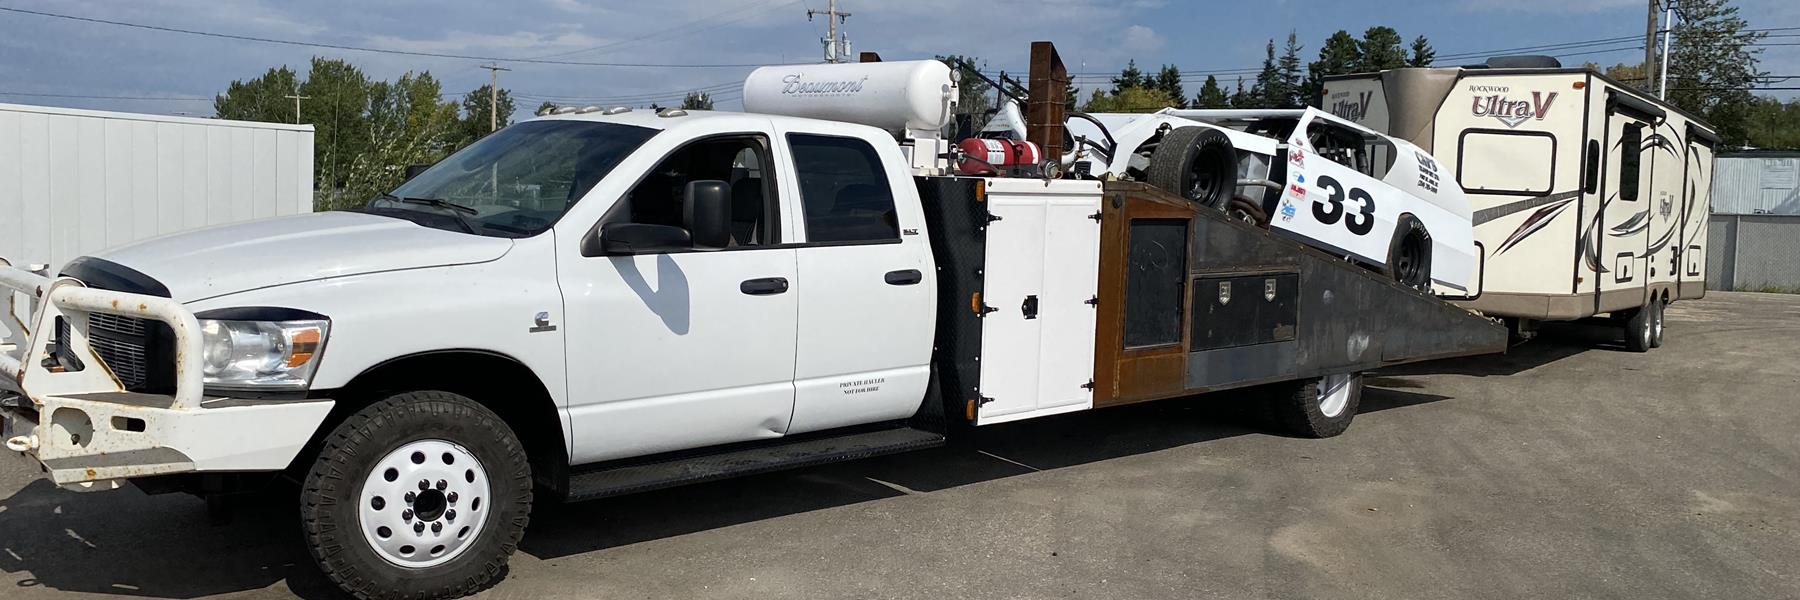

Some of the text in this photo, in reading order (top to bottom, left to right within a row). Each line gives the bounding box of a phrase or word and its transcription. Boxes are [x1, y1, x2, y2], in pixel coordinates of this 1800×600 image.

[782, 73, 868, 94] Beaumont
[1468, 85, 1509, 93] ROCKWOOD
[1312, 175, 1376, 236] 33
